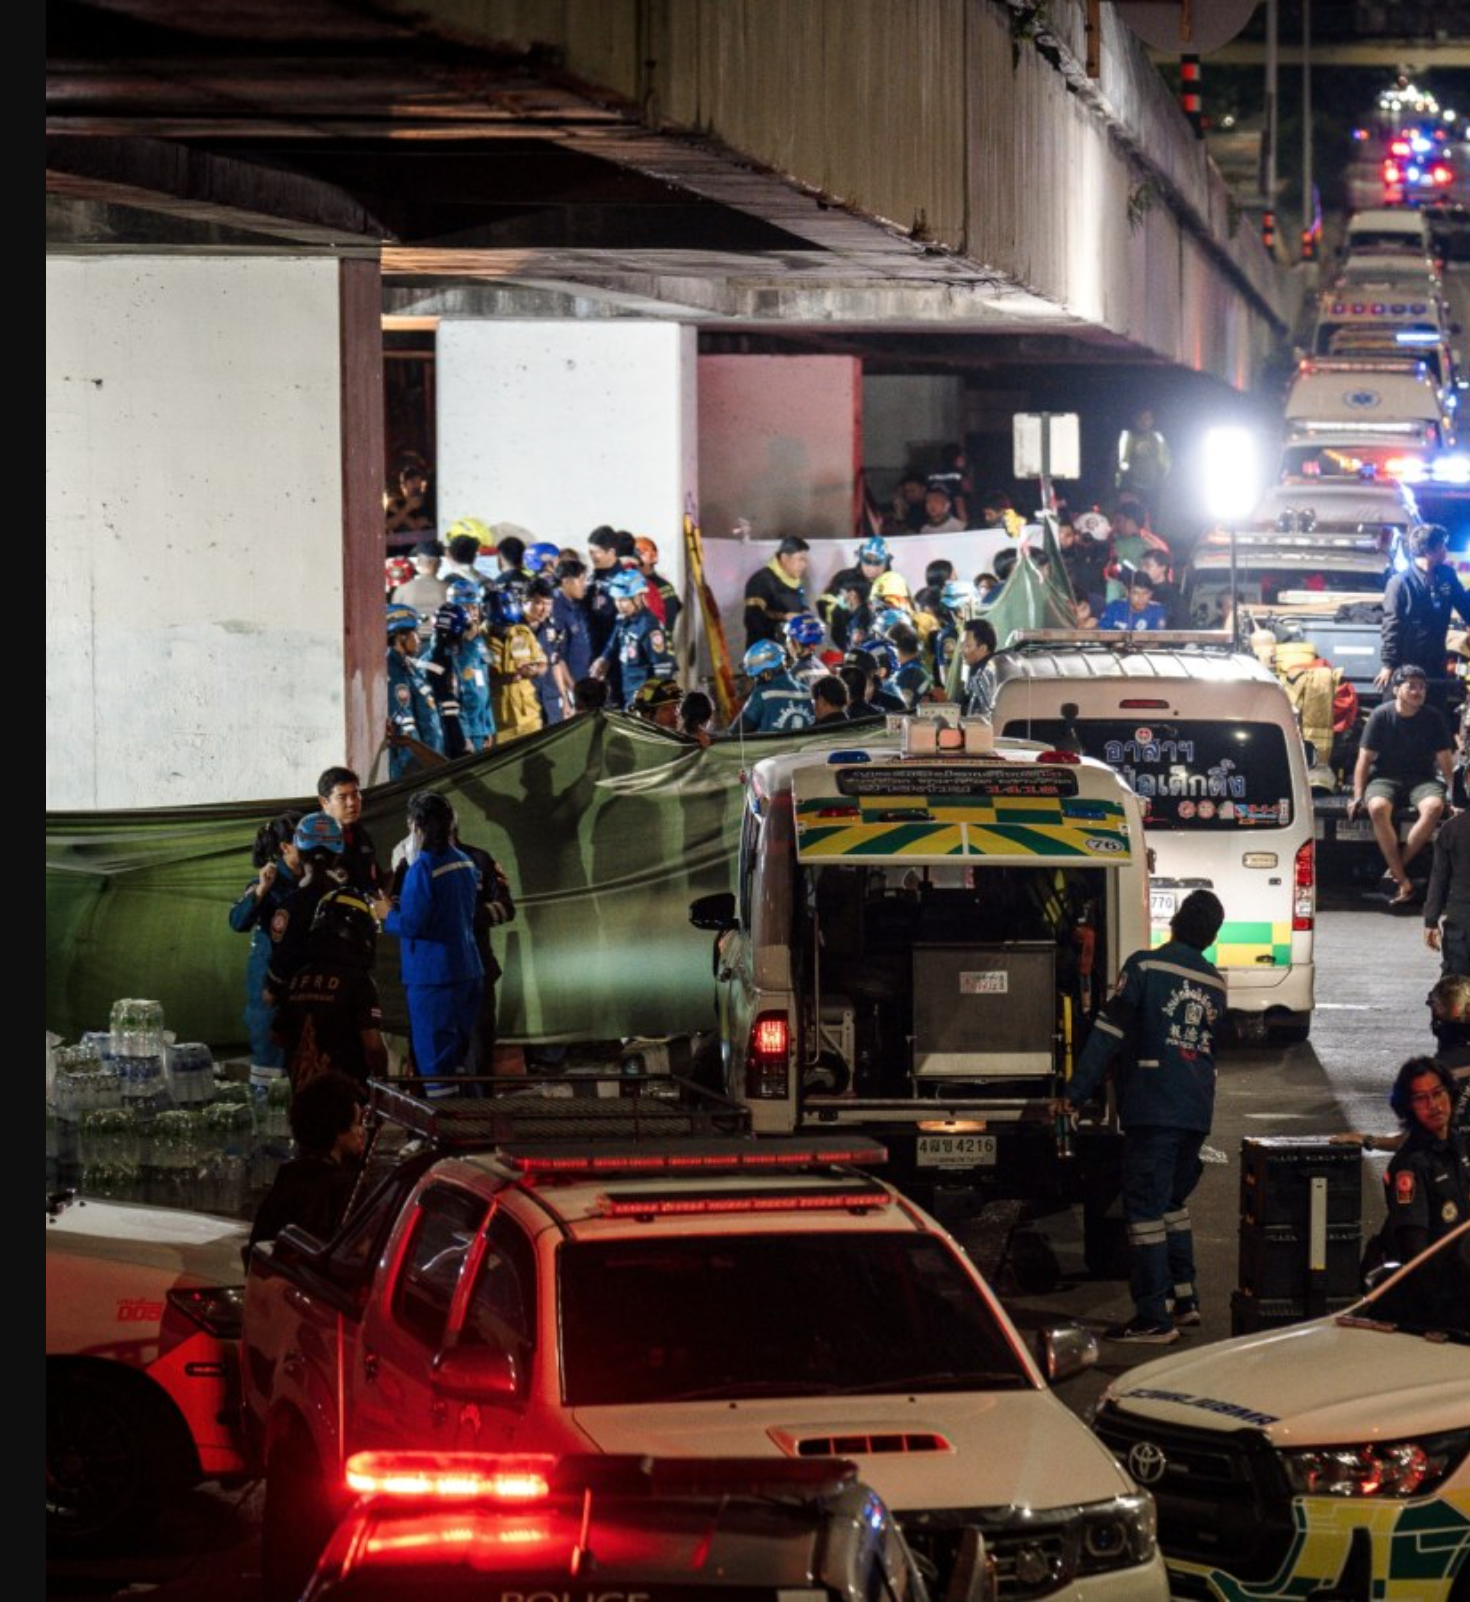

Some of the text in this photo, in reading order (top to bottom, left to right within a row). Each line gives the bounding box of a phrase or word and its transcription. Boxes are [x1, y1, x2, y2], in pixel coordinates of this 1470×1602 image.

[1104, 739, 1195, 763] อาสาฯ
[1092, 840, 1117, 850] 76
[956, 1139, 994, 1152] 4216
